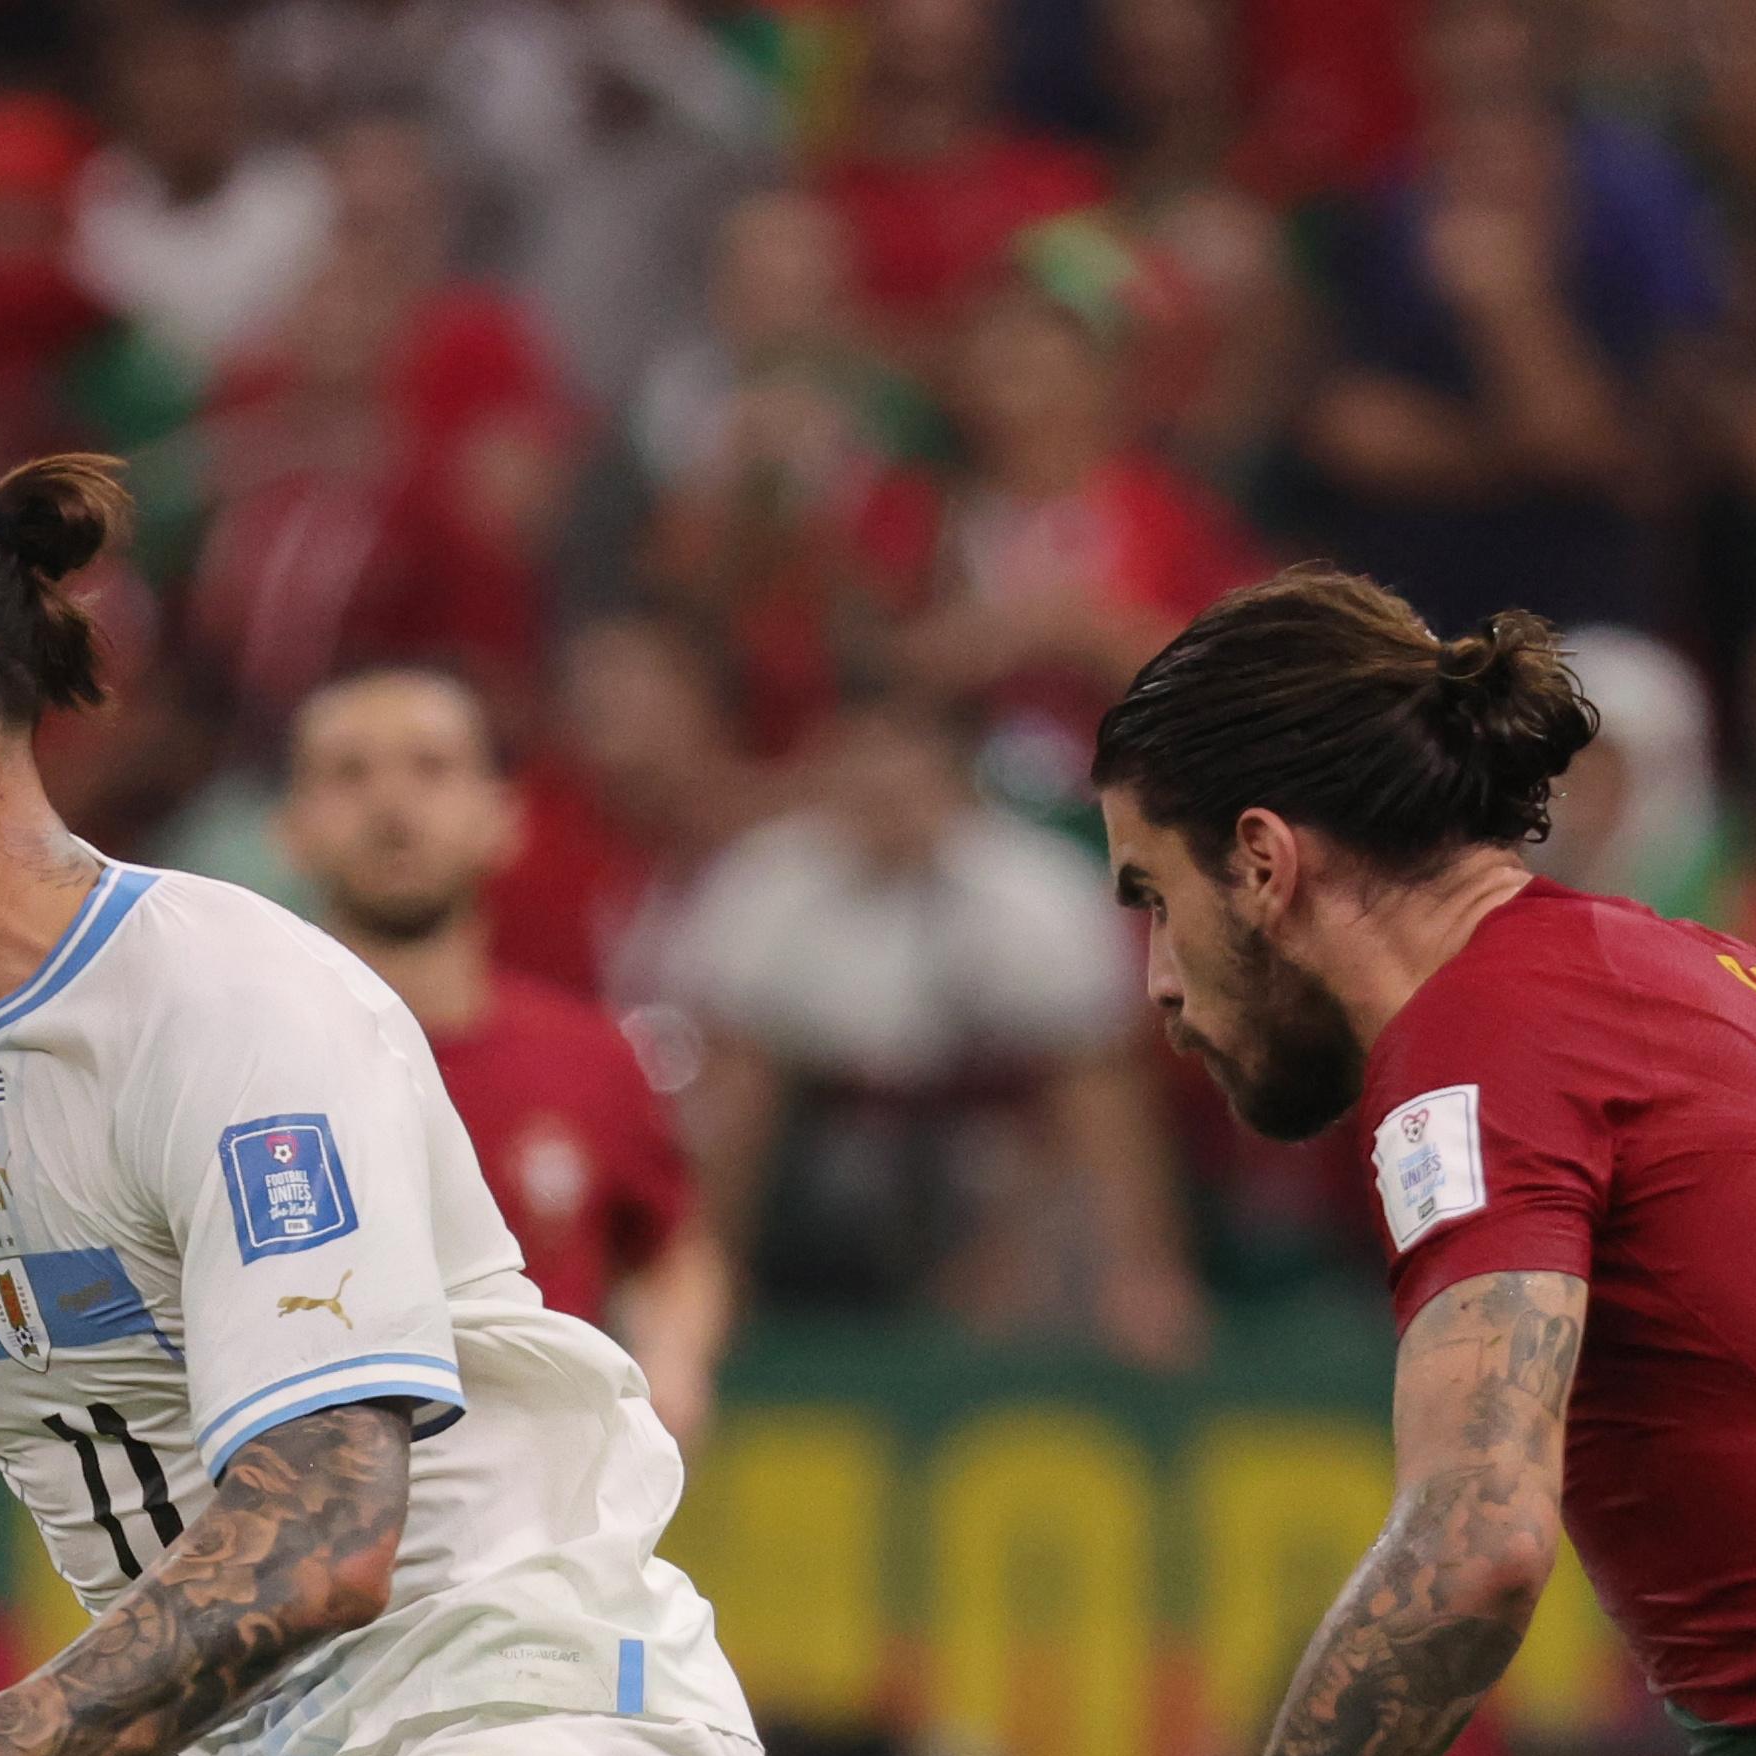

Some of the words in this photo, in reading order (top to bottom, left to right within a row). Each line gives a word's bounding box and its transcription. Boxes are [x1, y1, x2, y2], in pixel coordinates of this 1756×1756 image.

[264, 1169, 309, 1189] FOOTBALL
[267, 1184, 313, 1205] UNITES
[41, 1401, 185, 1581] 11
